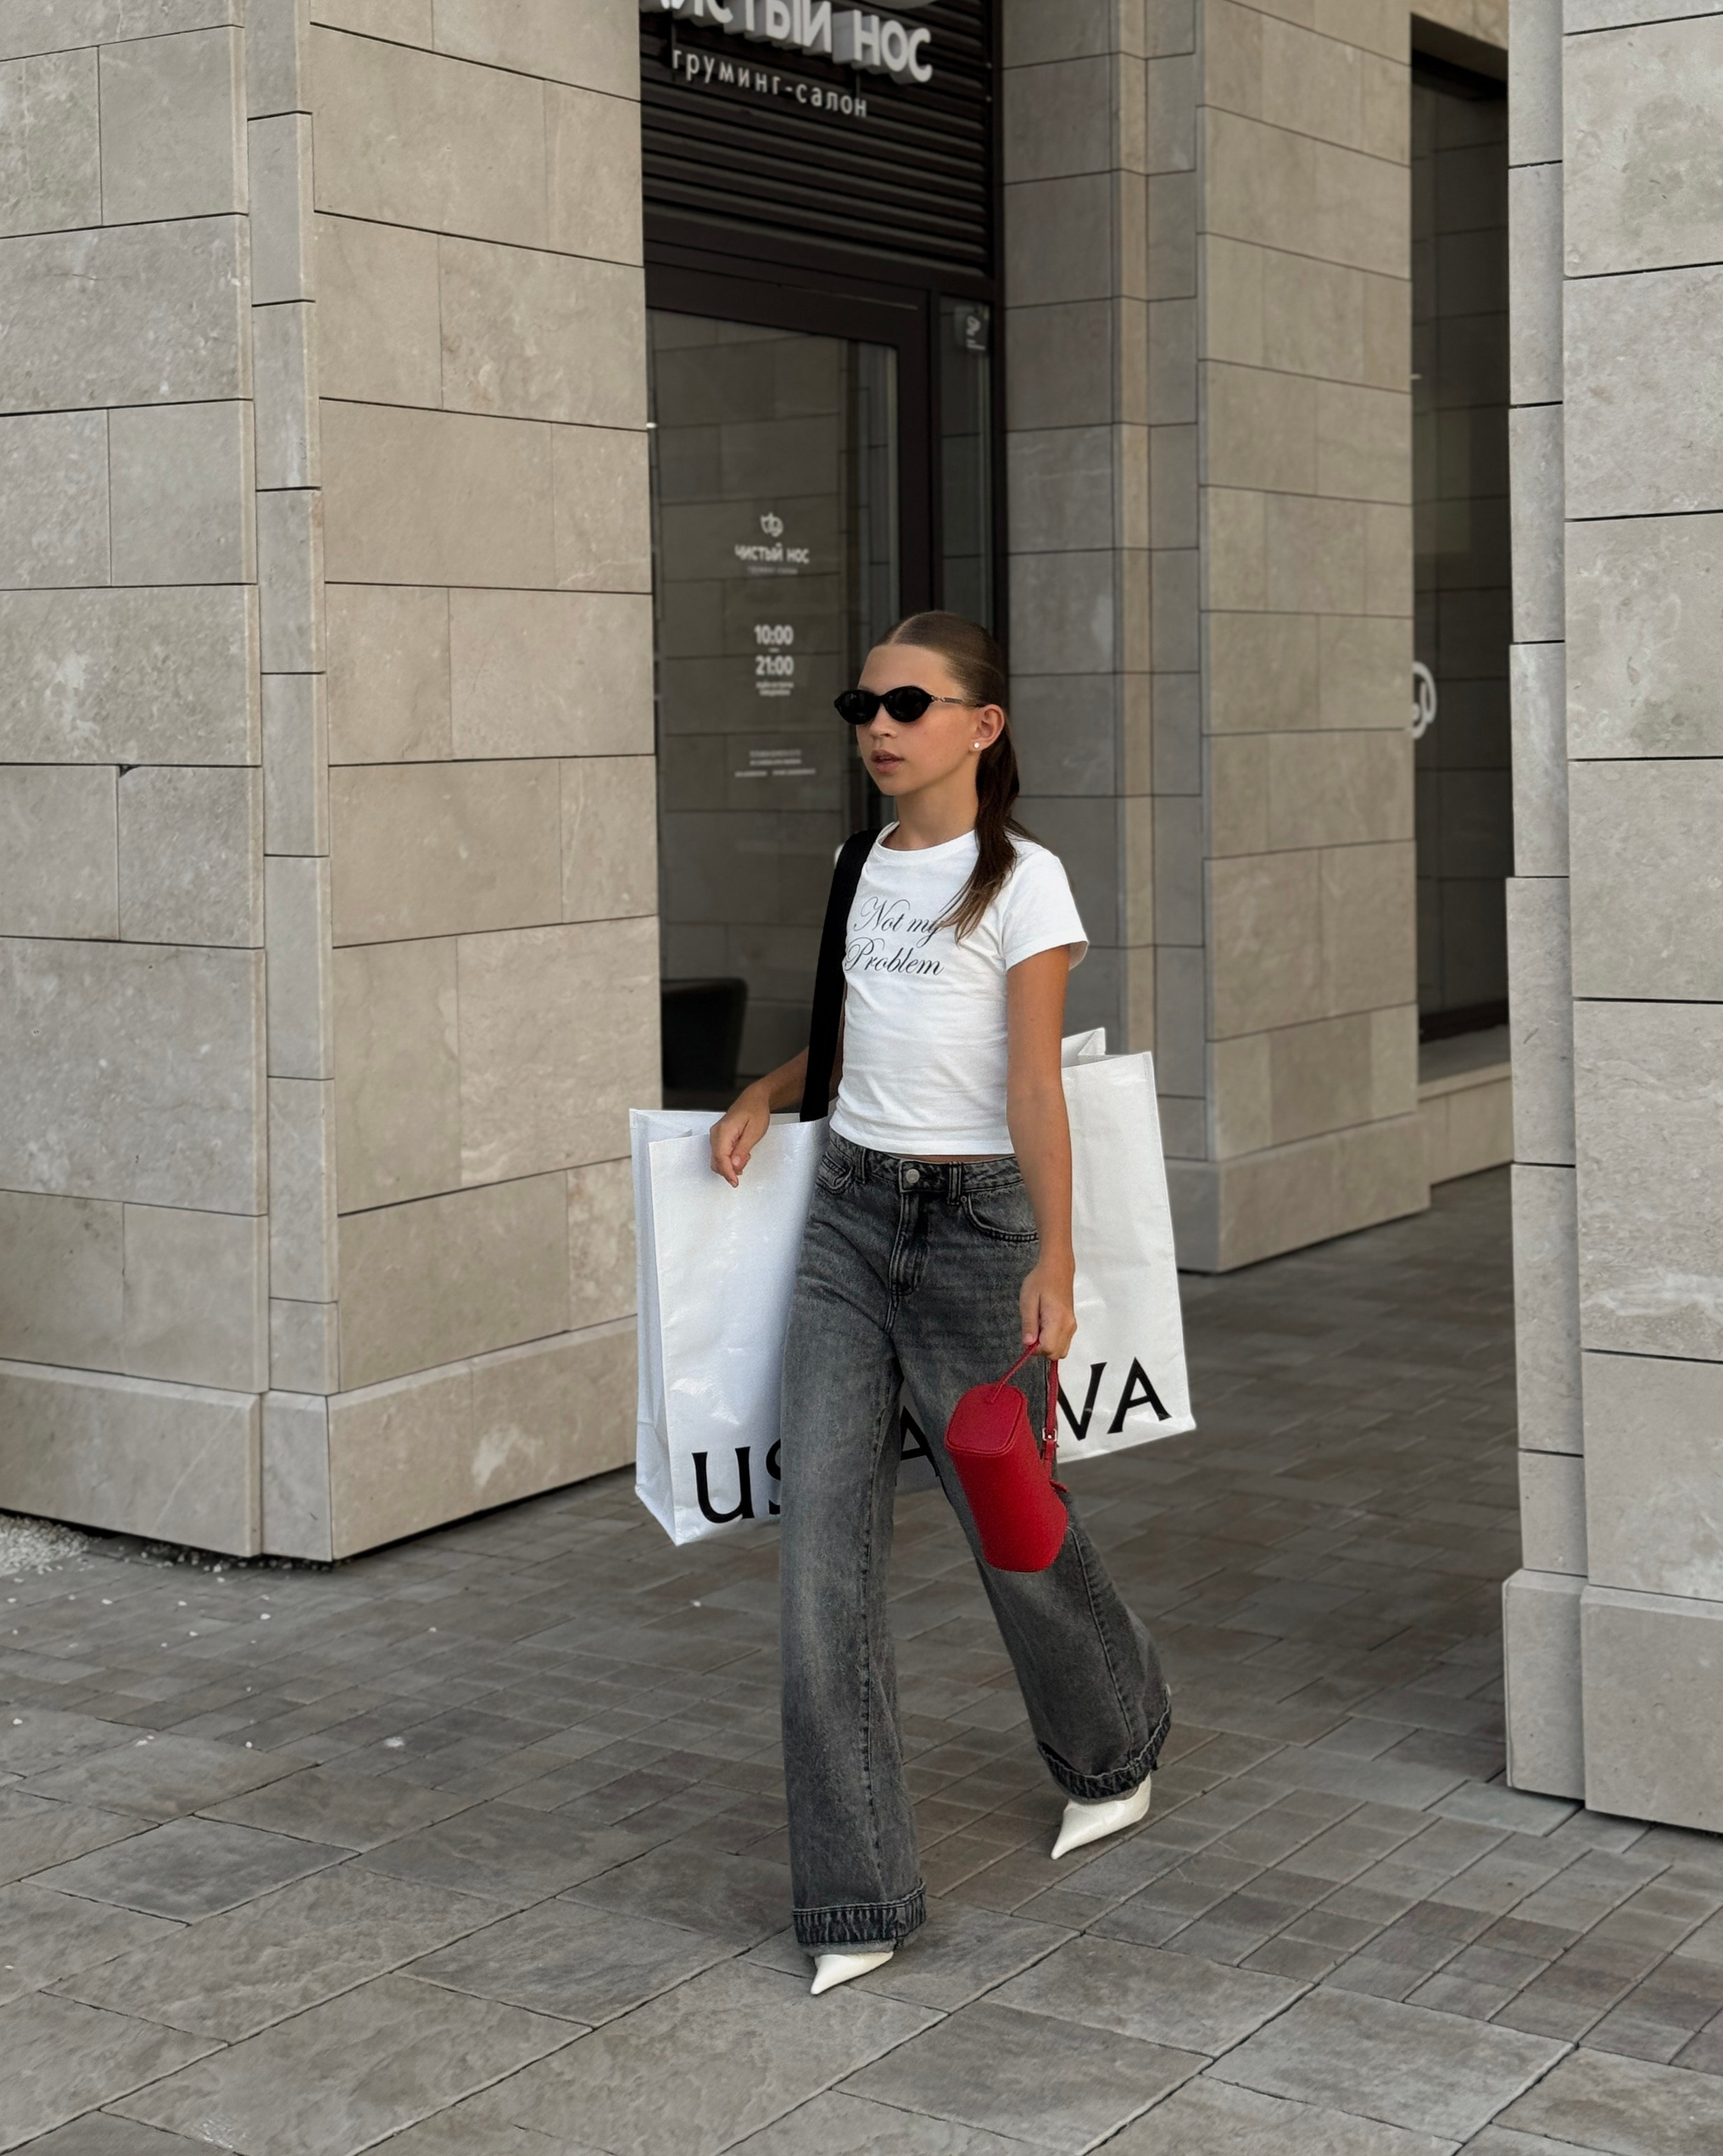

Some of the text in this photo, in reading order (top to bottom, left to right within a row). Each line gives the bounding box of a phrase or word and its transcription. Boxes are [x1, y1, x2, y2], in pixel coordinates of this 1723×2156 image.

[853, 10, 933, 83] НОС
[673, 49, 868, 117] груминг-салон
[754, 624, 793, 645] 10:00
[755, 655, 794, 675] 21:00
[853, 896, 910, 932] Not
[844, 937, 944, 975] Problem
